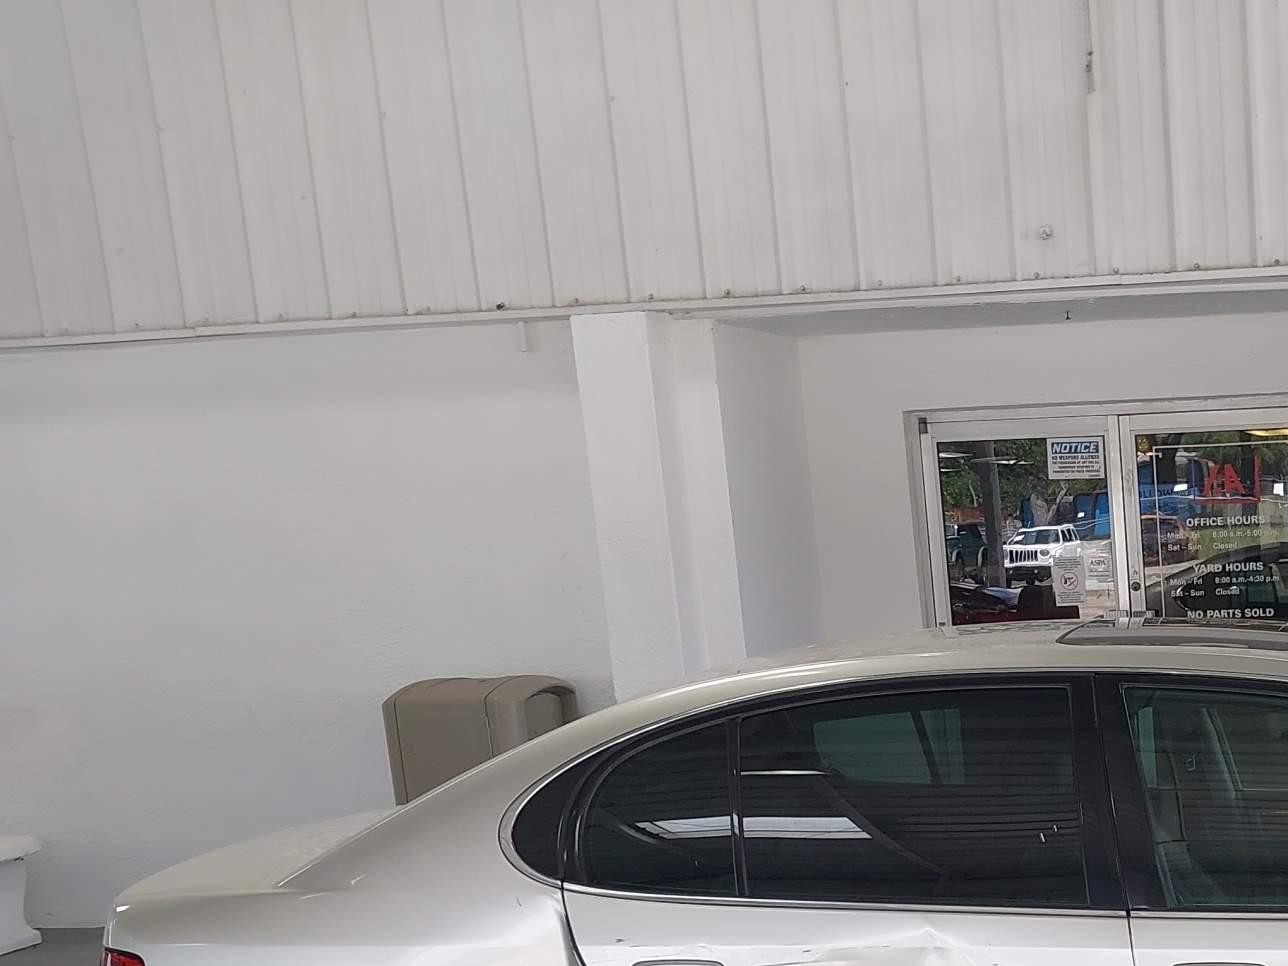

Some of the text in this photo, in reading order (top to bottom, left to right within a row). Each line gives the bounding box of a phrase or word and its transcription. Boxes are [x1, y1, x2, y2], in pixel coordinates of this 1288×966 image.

[1052, 442, 1098, 454] NOTICE
[1186, 515, 1265, 527] OFFICE HOURS
[1167, 543, 1181, 551] Sat
[1187, 543, 1202, 551] Sun
[1213, 542, 1239, 550] Closed
[1192, 561, 1264, 573] YARD HOURS
[1169, 578, 1186, 586] Mon
[1193, 577, 1203, 585] Fri
[1170, 590, 1183, 598] Sat
[1190, 589, 1205, 597] Sun
[1215, 587, 1240, 596] Closed
[1187, 608, 1275, 619] NO PARTS SOLD
